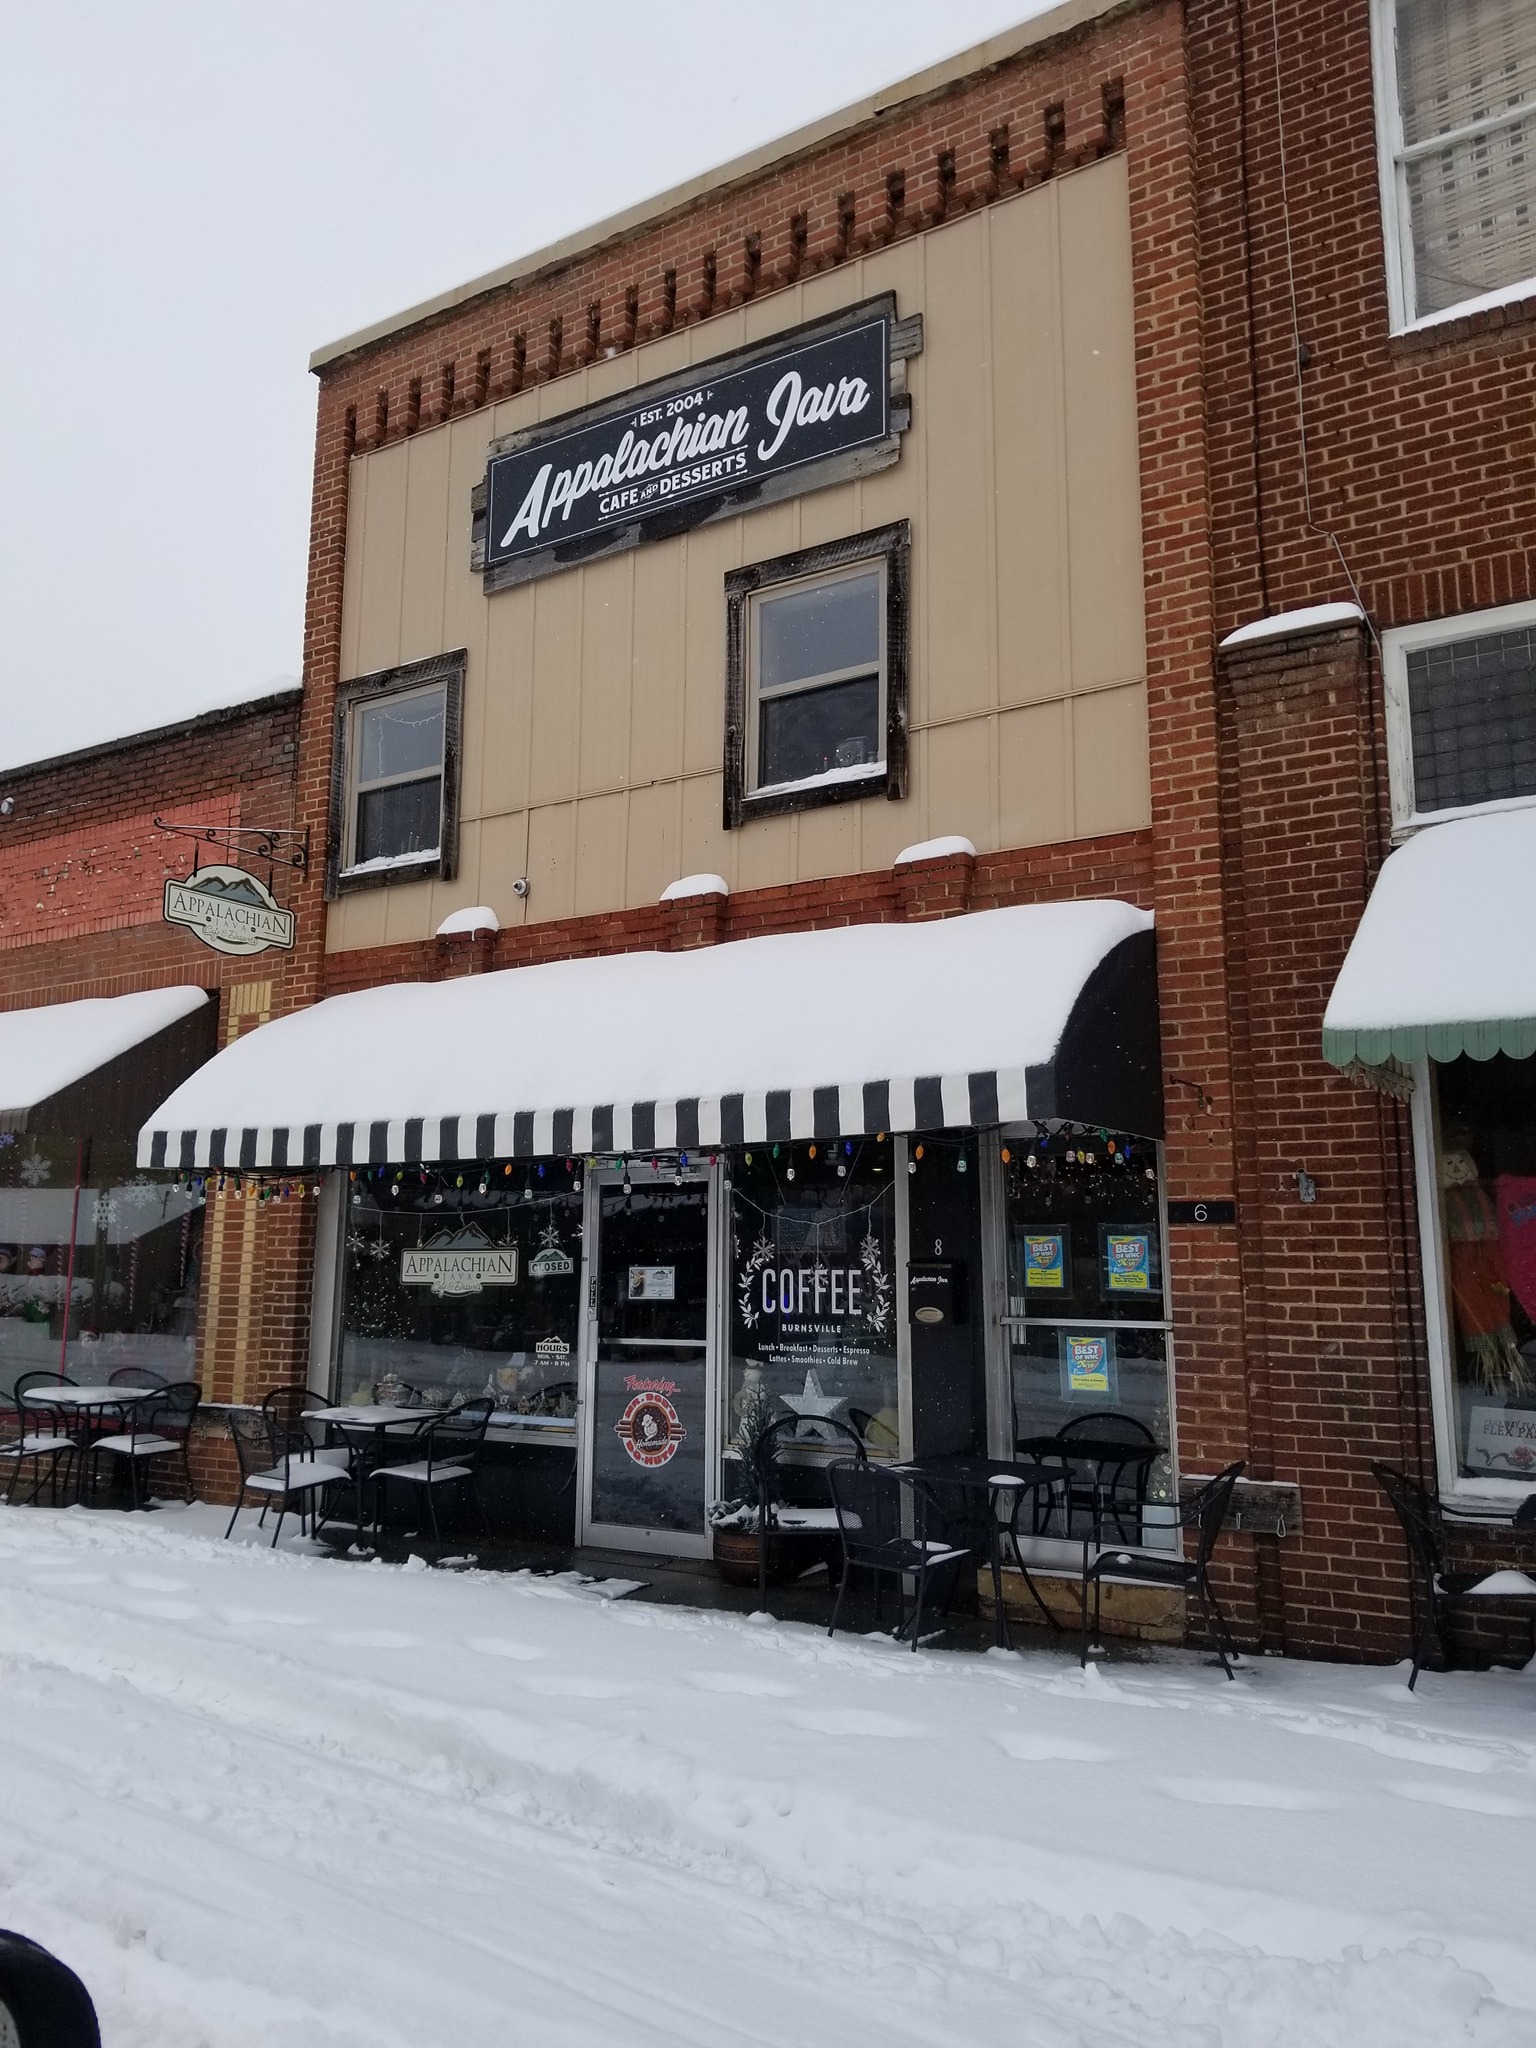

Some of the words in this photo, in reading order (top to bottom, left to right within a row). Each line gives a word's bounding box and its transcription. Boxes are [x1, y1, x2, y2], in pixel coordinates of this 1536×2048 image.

[640, 408, 664, 427] EST.
[666, 391, 704, 417] 2004
[500, 405, 749, 547] Appalachian
[757, 370, 870, 461] Java
[599, 488, 639, 514] CAFE
[640, 484, 658, 500] AND
[660, 452, 747, 495] DESSERTS
[173, 891, 288, 935] APPALACHIAN
[215, 918, 248, 932] JAVA
[1194, 1203, 1208, 1221] 6
[934, 1238, 942, 1256] 8
[1032, 1243, 1054, 1252] BEST
[1115, 1244, 1140, 1253] BEST
[405, 1254, 512, 1274] APPALACHIAN
[531, 1261, 570, 1272] CLOSED
[442, 1272, 473, 1280] JAVA
[762, 1268, 862, 1315] COFFEE
[781, 1323, 841, 1333] BURNSVILLE
[537, 1344, 568, 1353] HOURS
[758, 1342, 775, 1351] Lunch
[779, 1343, 808, 1353] Breakfast
[812, 1344, 839, 1353] Desserts
[843, 1345, 870, 1355] Espresso
[1074, 1345, 1099, 1355] BEST
[769, 1354, 787, 1363] Lattes
[791, 1355, 822, 1365] Smoothies
[827, 1356, 841, 1365] Cold
[842, 1357, 858, 1366] Brew
[1483, 1424, 1513, 1437] FLEX
[1518, 1427, 1536, 1439] PA
